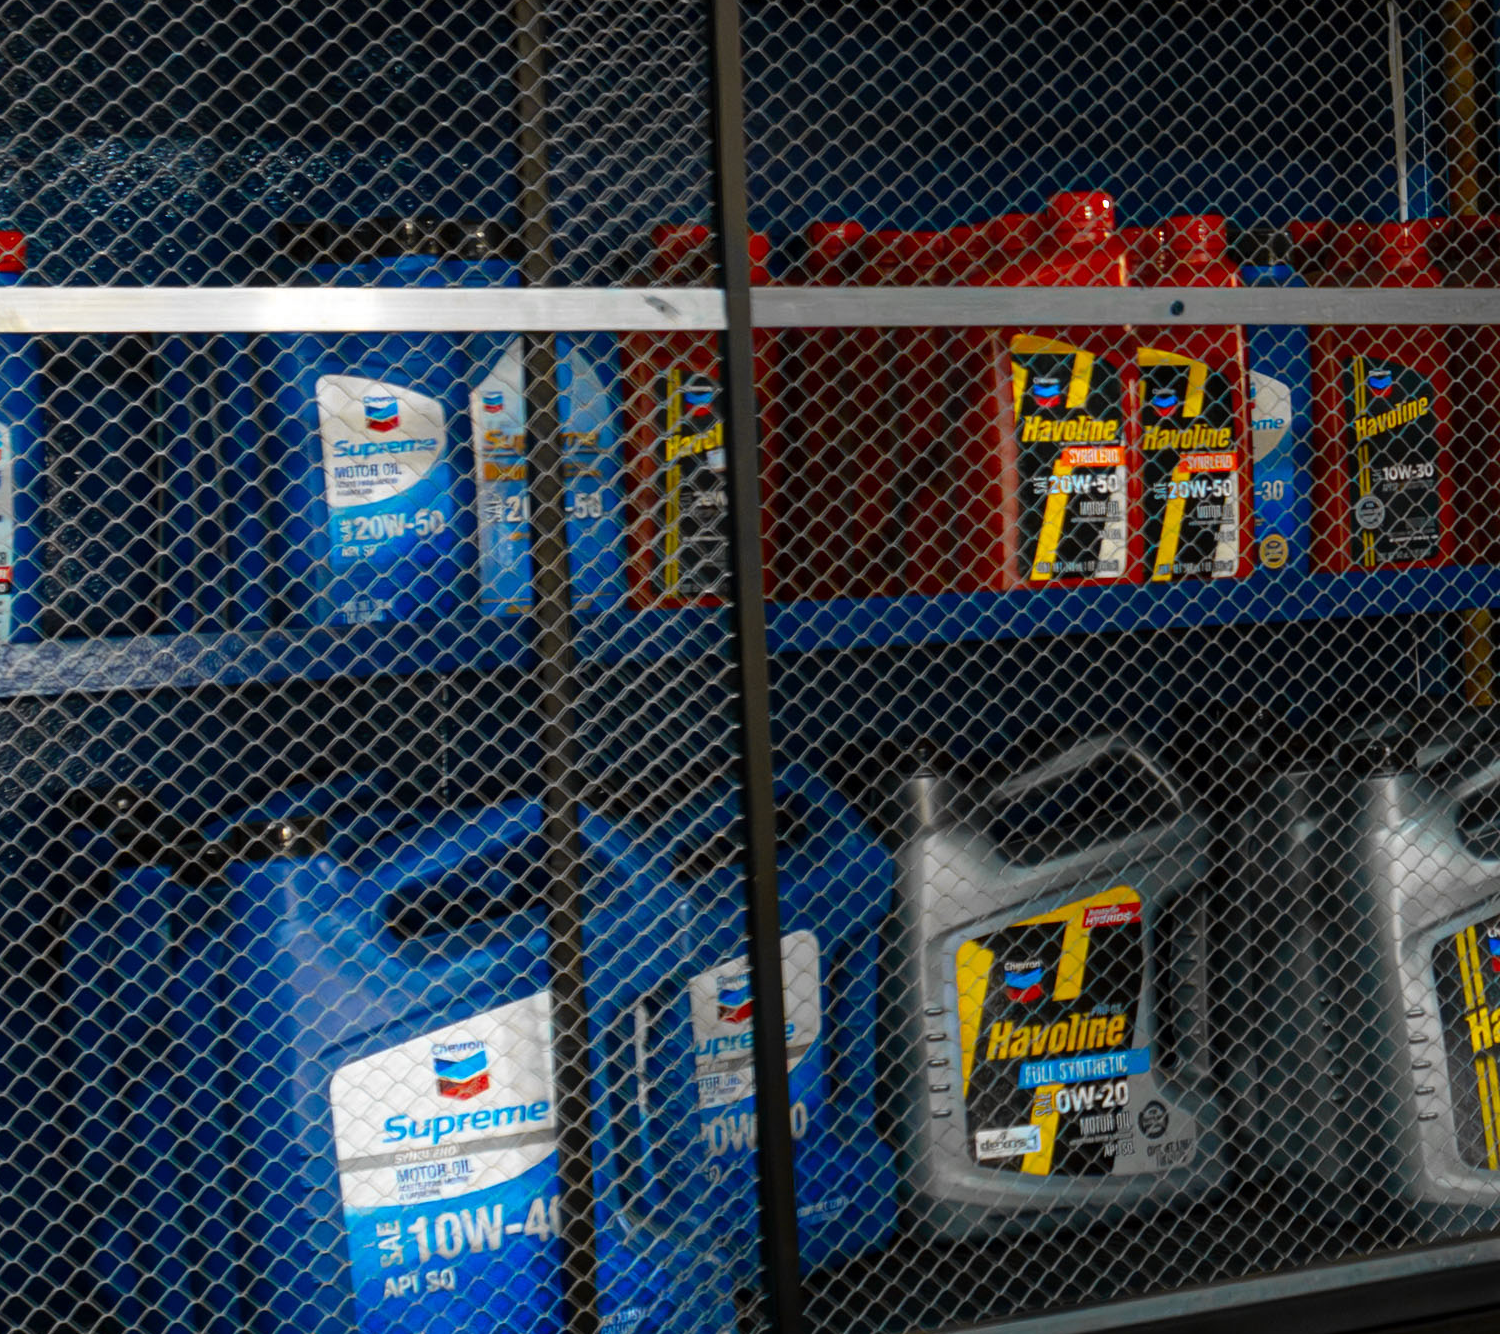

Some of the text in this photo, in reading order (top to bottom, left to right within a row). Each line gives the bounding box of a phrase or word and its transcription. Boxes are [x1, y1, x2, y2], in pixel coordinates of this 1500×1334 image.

[1021, 415, 1120, 443] Havoline
[1354, 395, 1430, 443] Havoline
[333, 436, 438, 459] Supreme
[1142, 423, 1232, 451] Havoline
[1049, 474, 1119, 495] 20W-50
[1382, 463, 1435, 481] 10W-30
[1168, 479, 1234, 499] 20W-50
[354, 508, 445, 542] 20W-50
[431, 1040, 486, 1057] Chevron
[986, 1013, 1129, 1061] Havoline
[1023, 1055, 1129, 1085] FULL SYNTHETIC
[1055, 1081, 1129, 1114] 0W-20
[382, 1098, 551, 1146] Supreme
[395, 1162, 449, 1184] MOTOR
[378, 1218, 404, 1268] SAE
[381, 1273, 418, 1299] API
